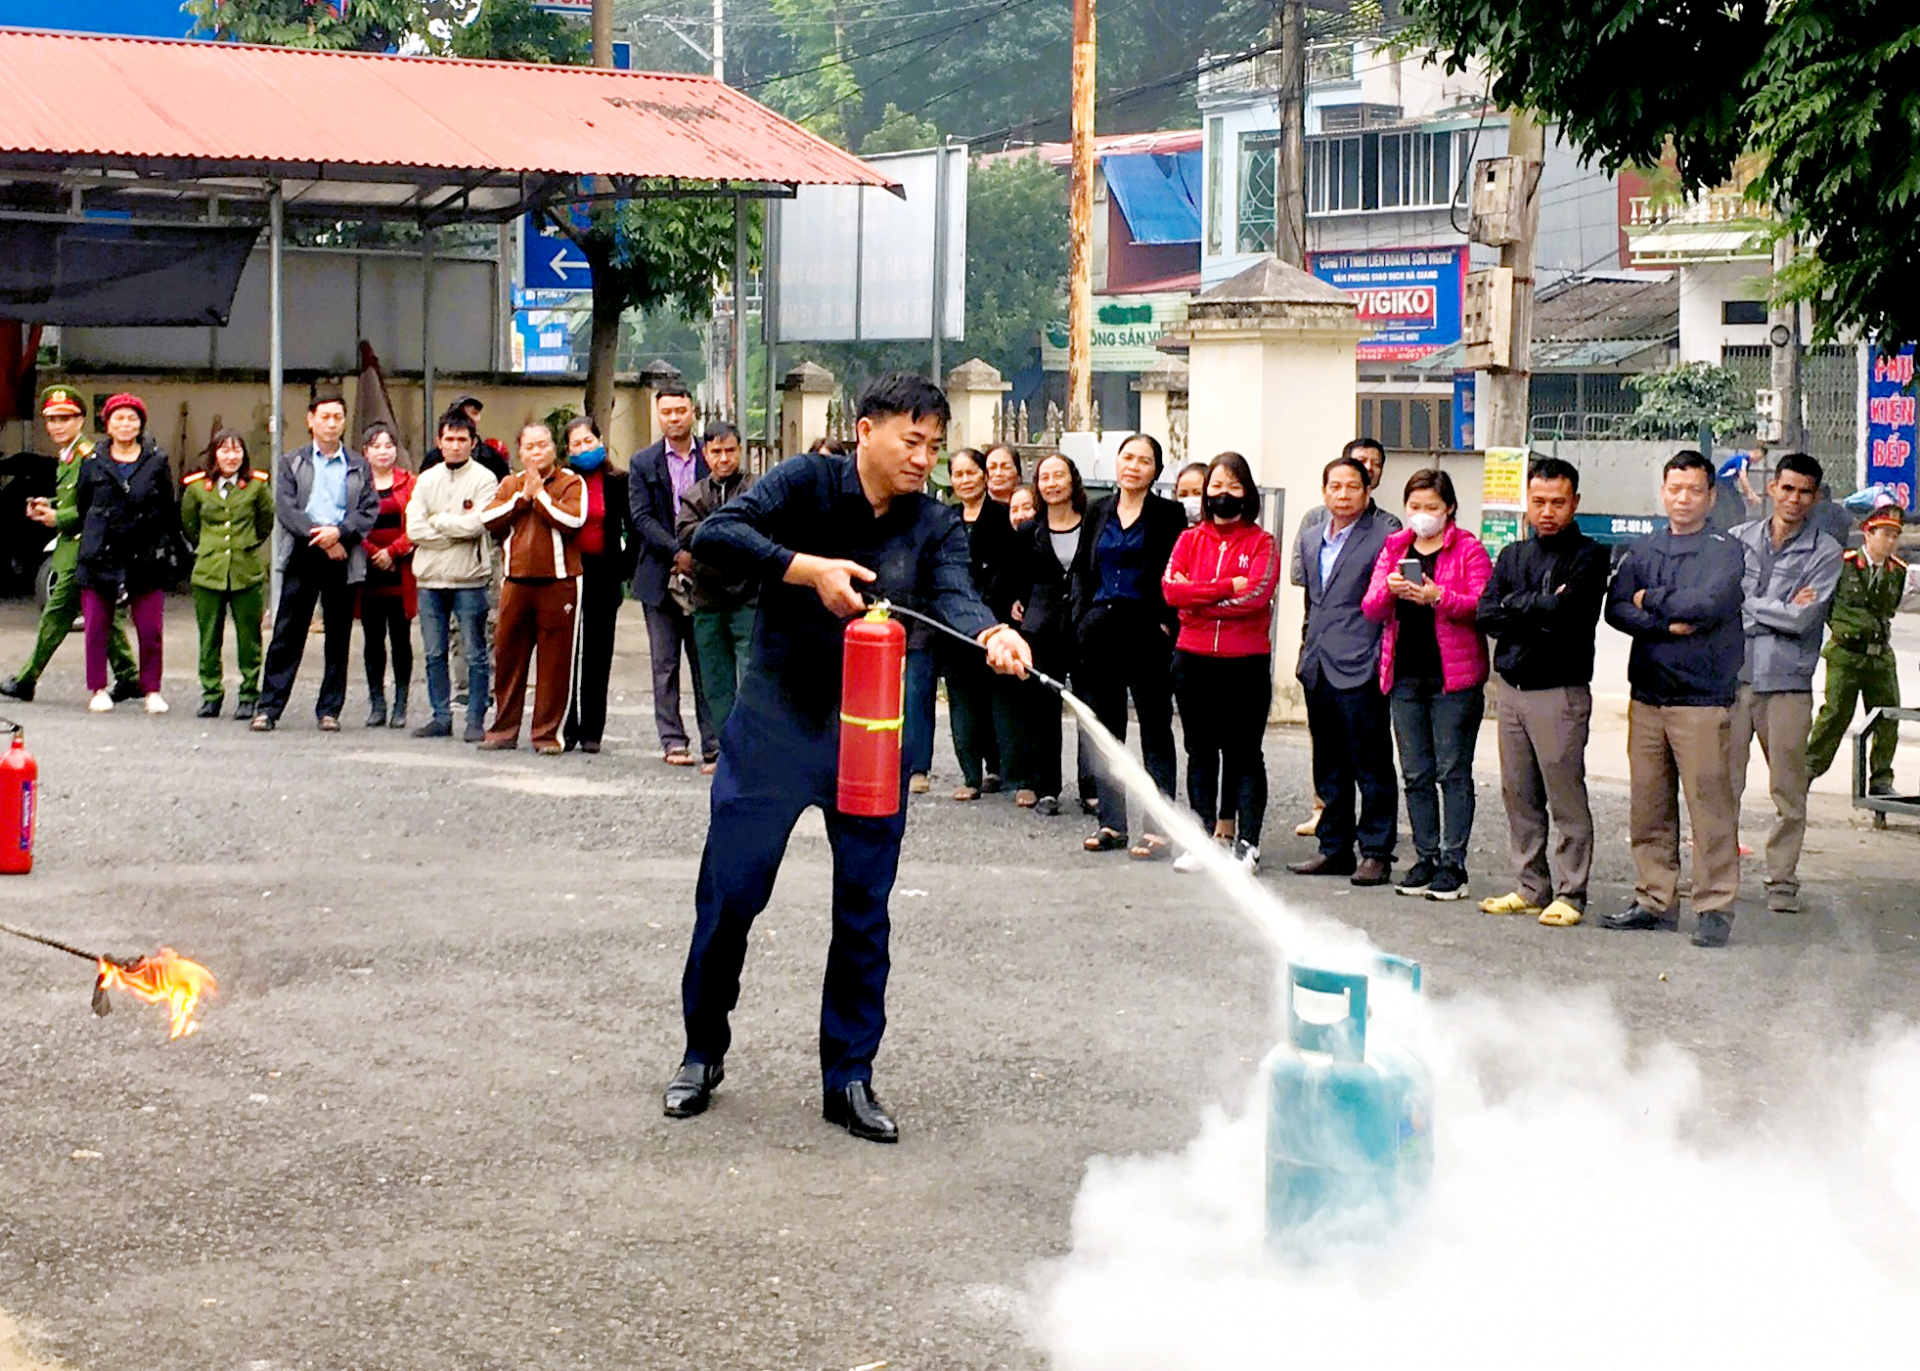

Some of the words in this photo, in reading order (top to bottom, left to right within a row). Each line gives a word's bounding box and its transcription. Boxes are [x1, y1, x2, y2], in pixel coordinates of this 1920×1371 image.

[1353, 290, 1429, 314] VIGIKO
[1119, 327, 1145, 346] SẢN
[1870, 392, 1915, 430] KIỆN
[1873, 432, 1910, 467] BẾP
